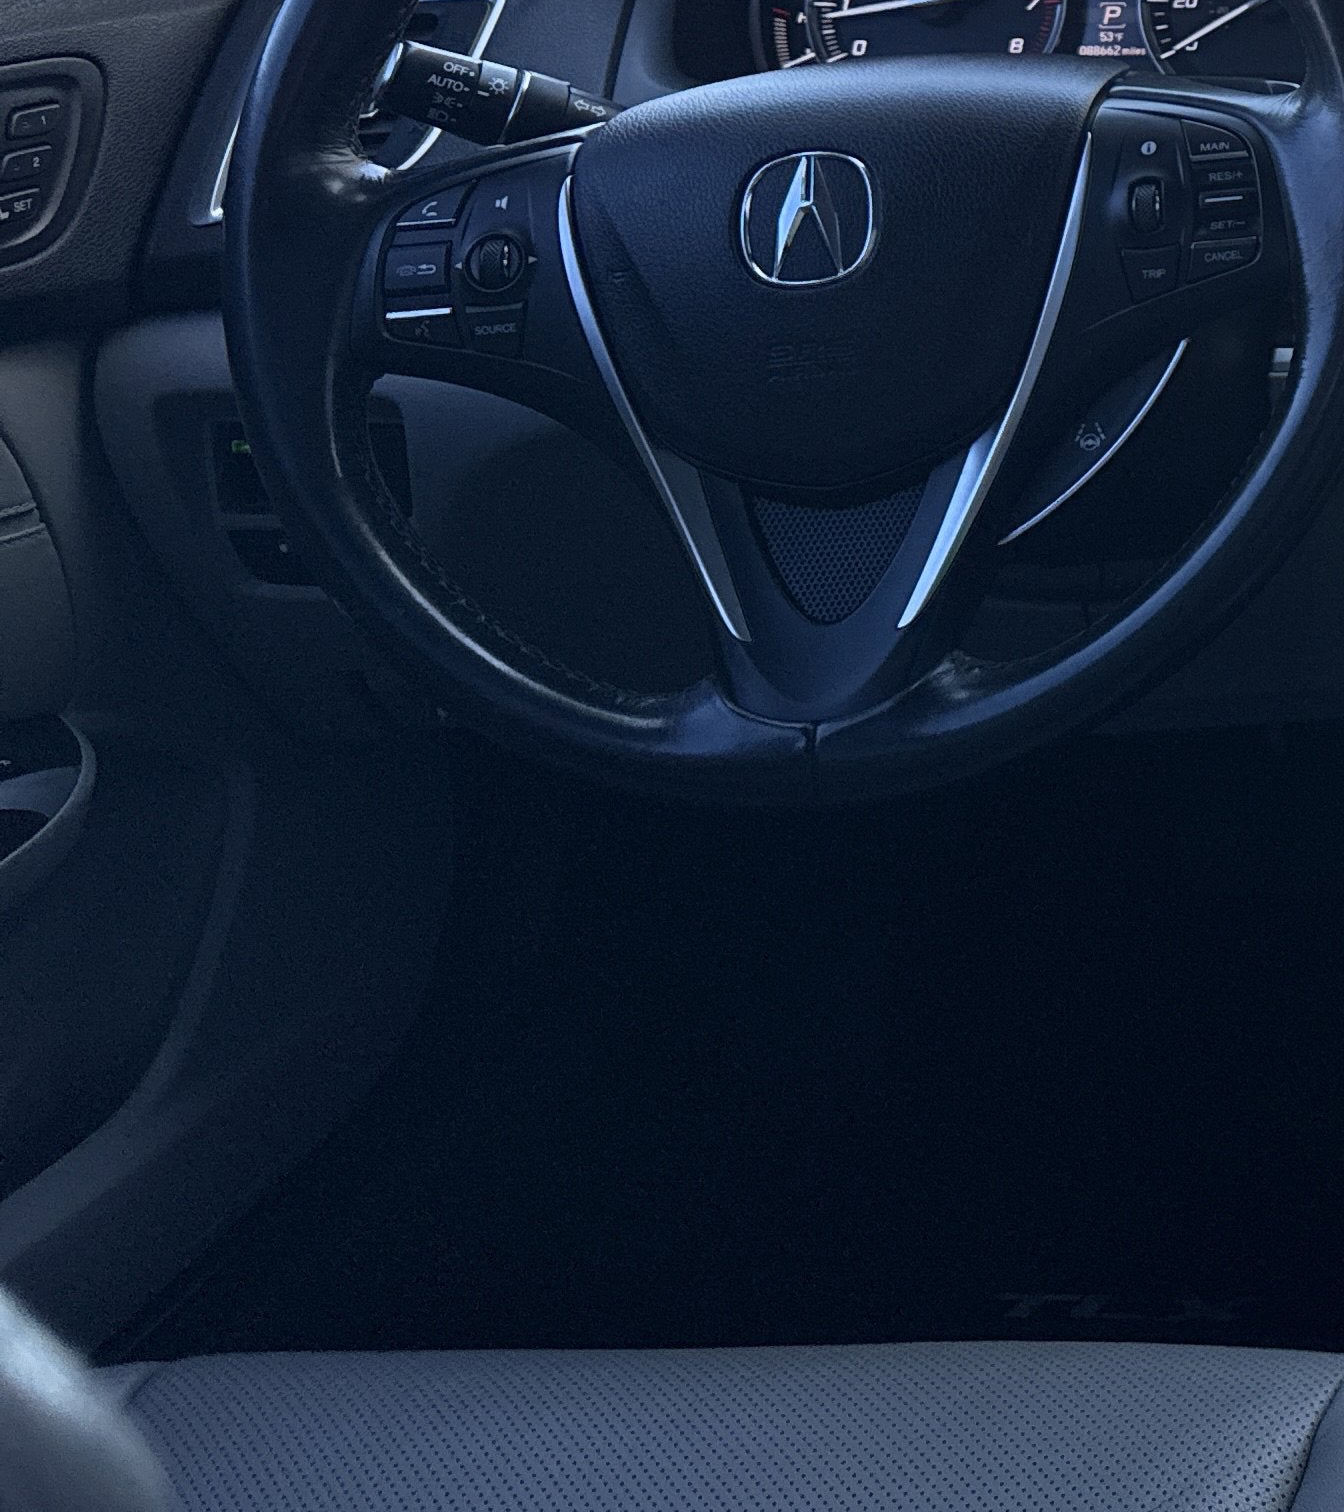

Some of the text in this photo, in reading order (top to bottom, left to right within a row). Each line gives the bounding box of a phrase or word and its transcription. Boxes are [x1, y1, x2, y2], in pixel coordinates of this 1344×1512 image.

[1103, 5, 1123, 26] P
[851, 38, 869, 57] 0
[1008, 36, 1025, 55] 8
[1078, 44, 1121, 57] 088662
[443, 61, 471, 77] OFF
[426, 73, 464, 93] AUTO
[1200, 141, 1231, 154] MAIN
[32, 156, 42, 169] 2
[12, 198, 34, 213] SET
[1203, 249, 1244, 264] CANCEL
[1141, 268, 1167, 281] TRIP
[474, 321, 517, 336] SOURCE
